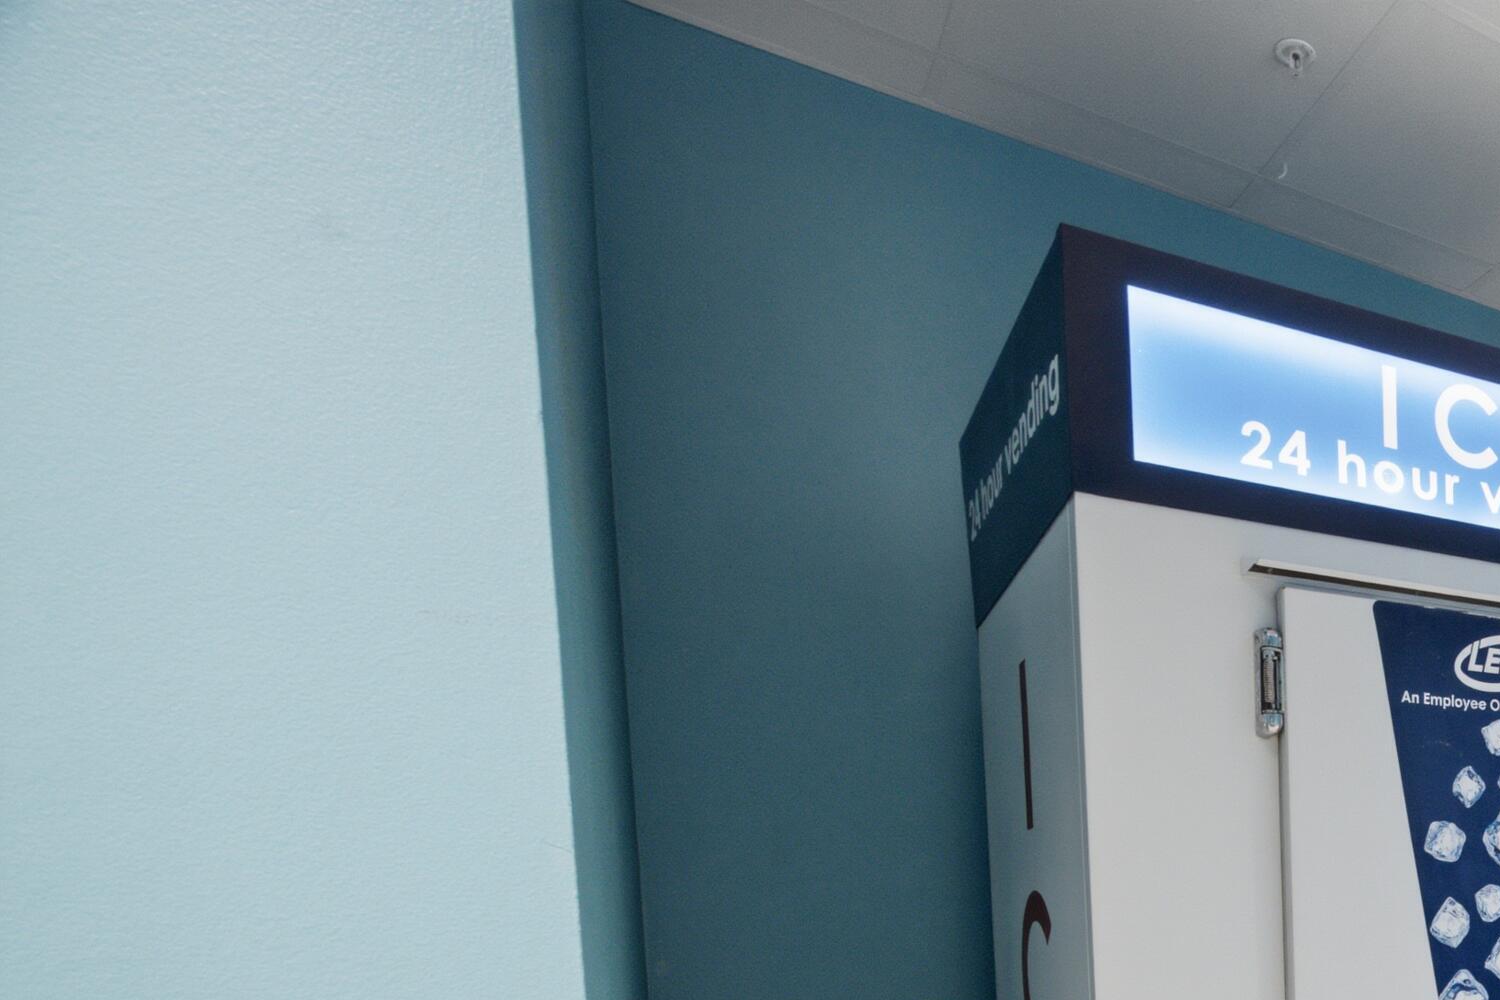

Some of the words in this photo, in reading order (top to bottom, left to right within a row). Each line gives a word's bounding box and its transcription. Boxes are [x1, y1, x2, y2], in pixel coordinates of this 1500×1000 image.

[968, 488, 982, 542] 24
[980, 453, 1003, 520] hour
[1004, 354, 1060, 475] vending
[1240, 420, 1311, 476] 24
[1337, 439, 1460, 505] hour
[1401, 690, 1420, 704] An
[1423, 692, 1487, 711] Employee
